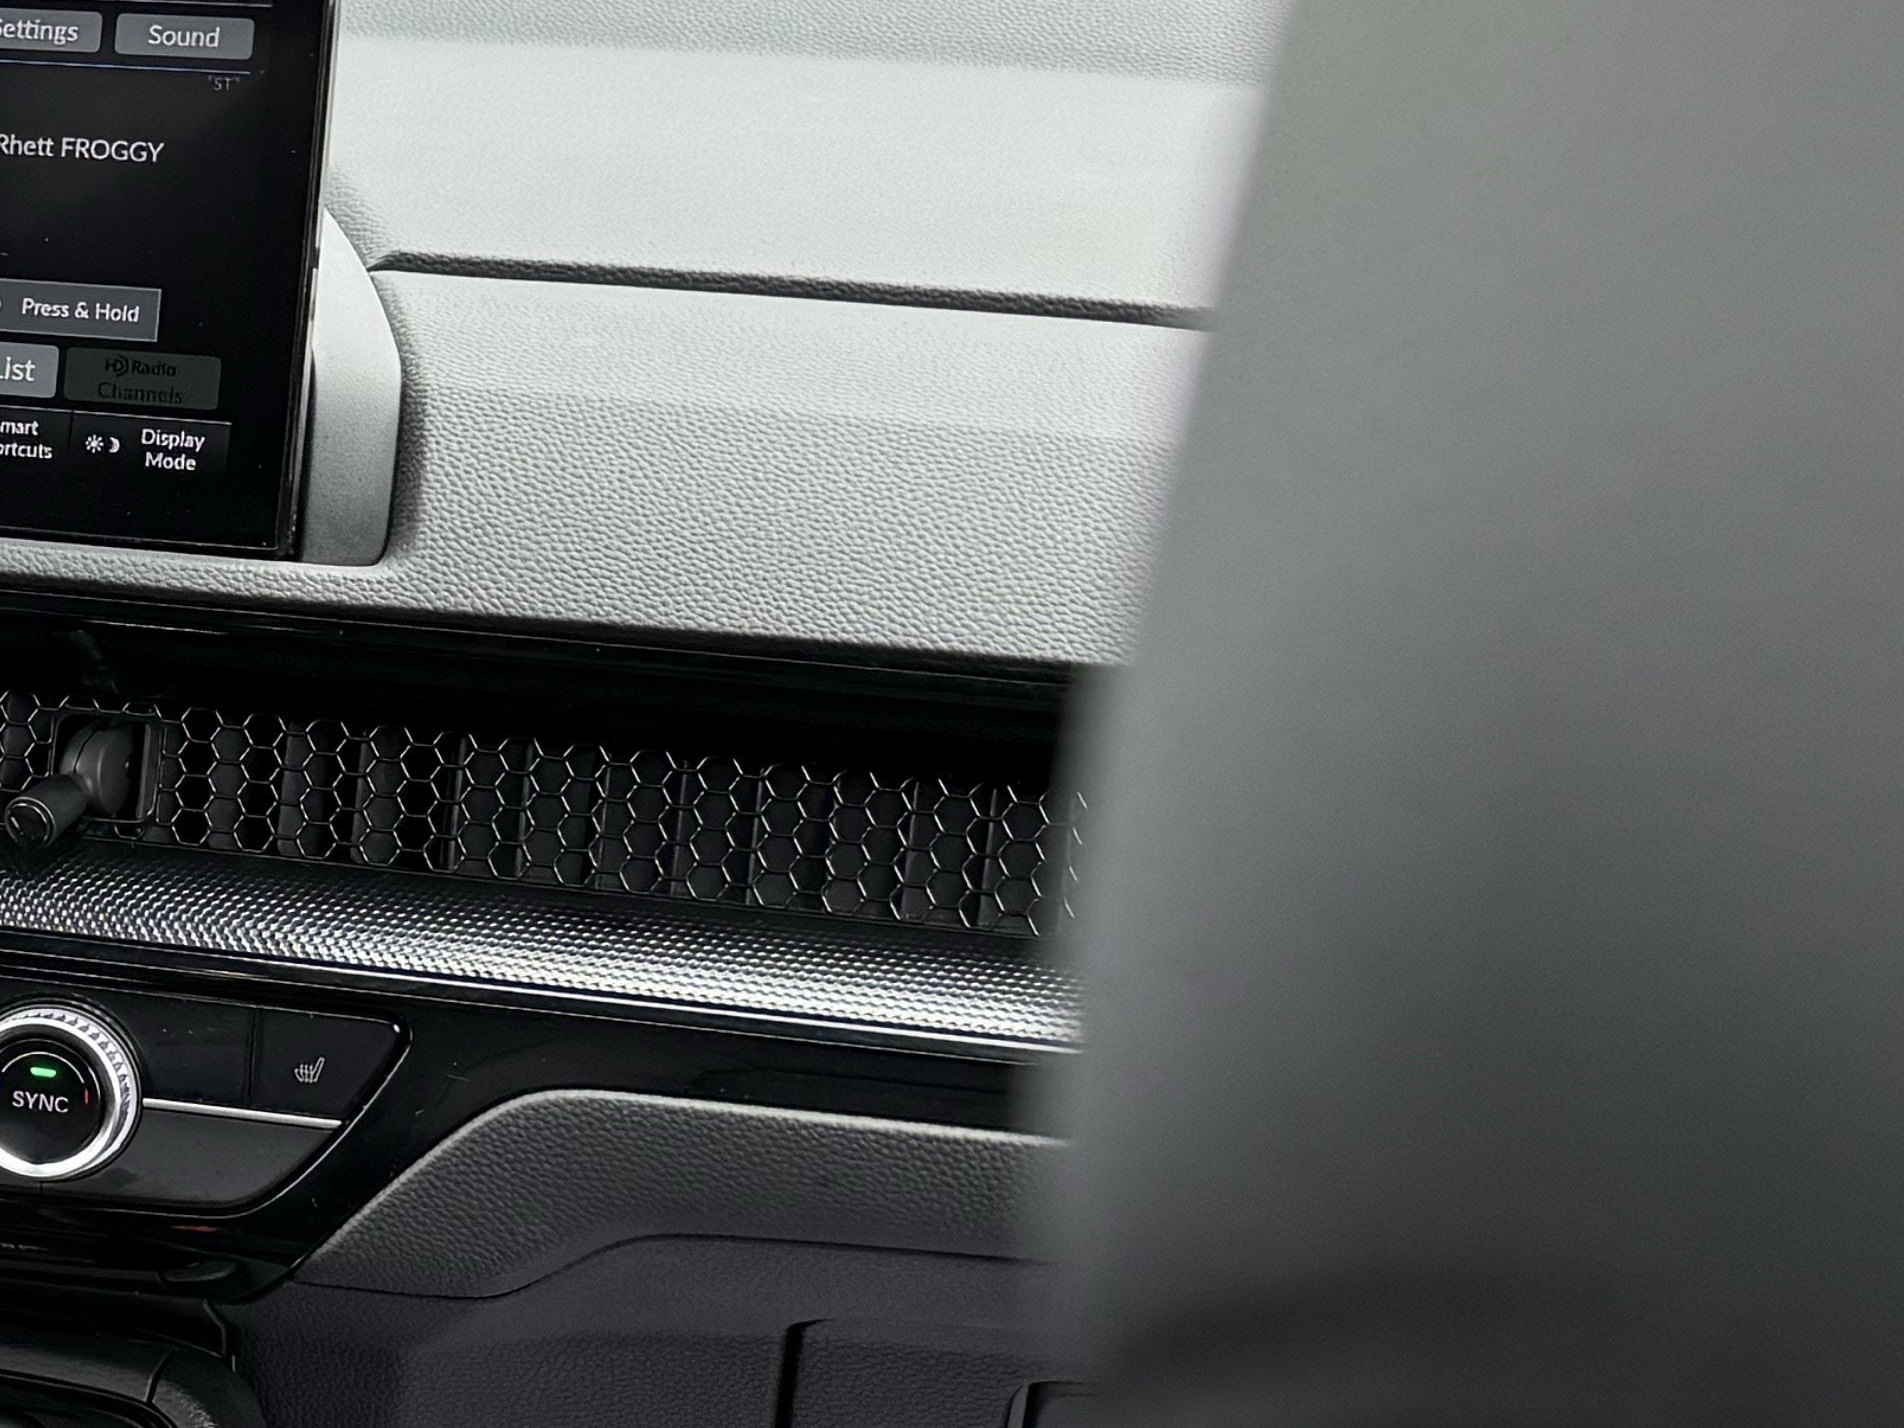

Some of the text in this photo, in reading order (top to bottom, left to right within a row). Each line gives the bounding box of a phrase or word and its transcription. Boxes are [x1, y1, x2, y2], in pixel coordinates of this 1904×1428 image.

[147, 25, 220, 48] Sound
[60, 137, 165, 163] FROGGY
[21, 297, 139, 323] Press & Hold
[141, 428, 206, 455] Display
[144, 451, 197, 471] Mode
[11, 1089, 69, 1116] SYNC
